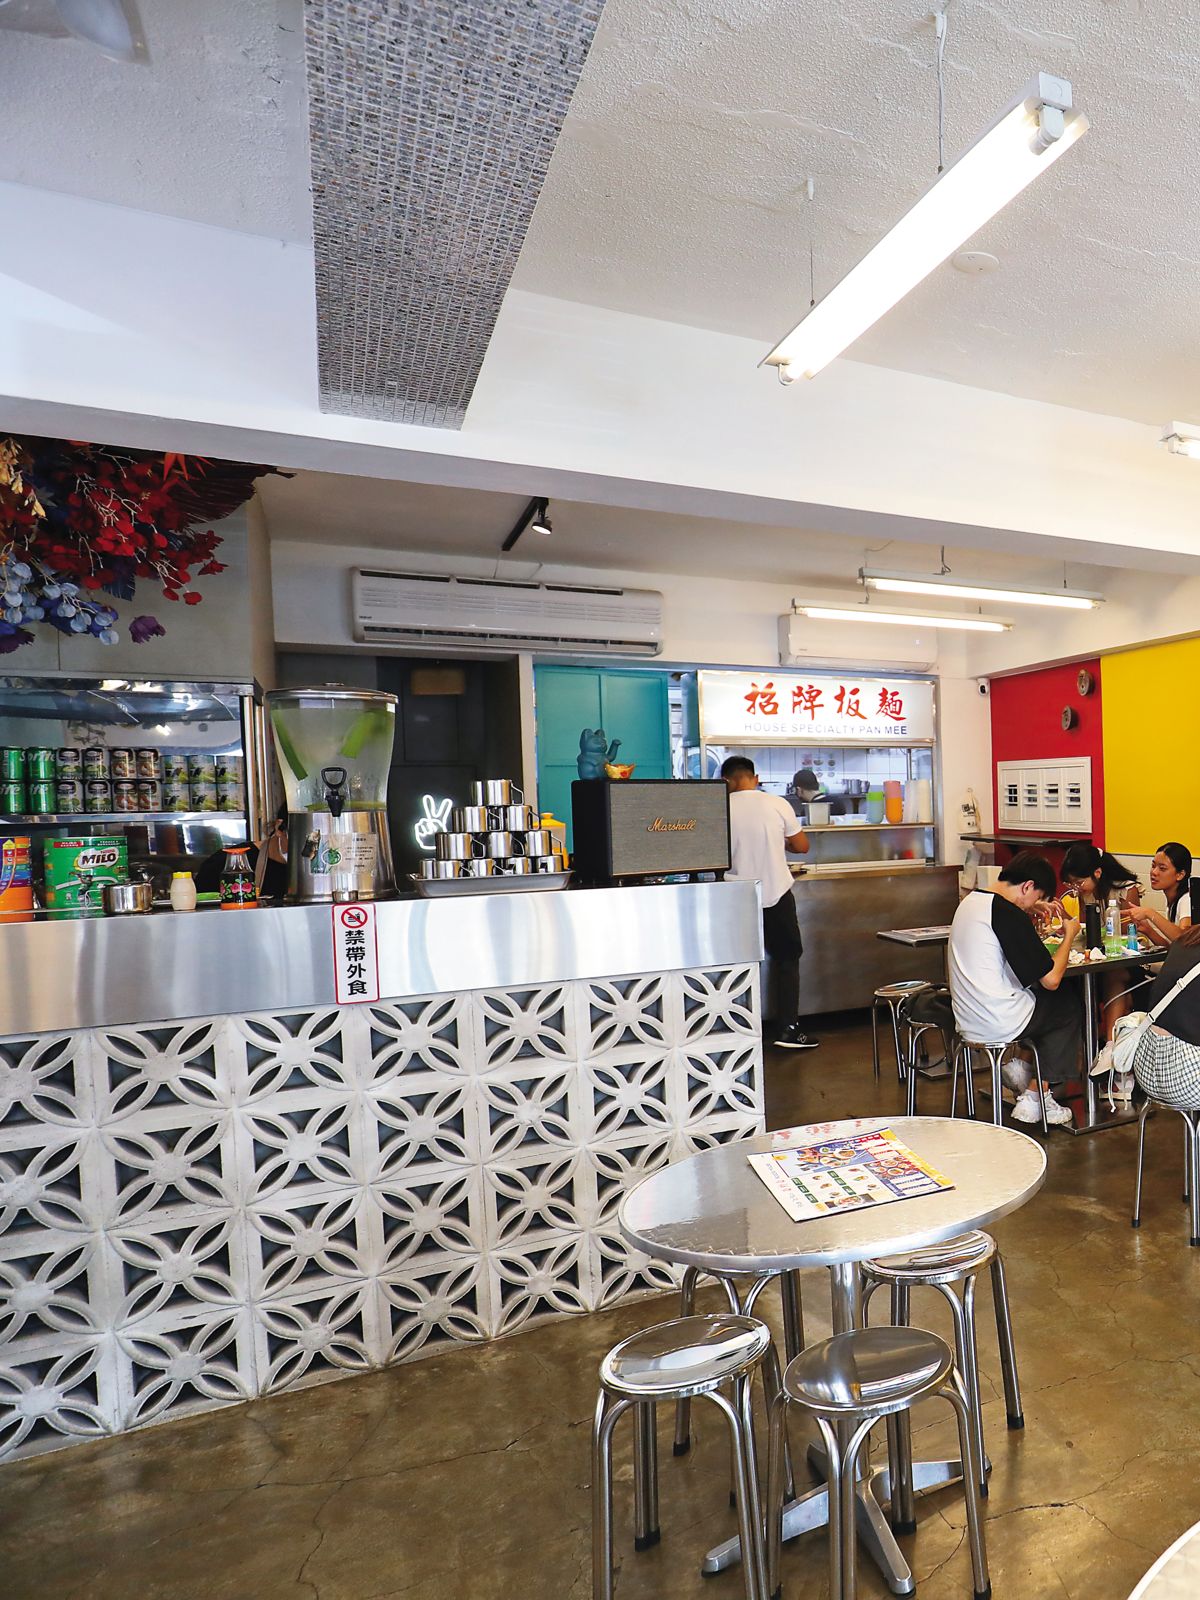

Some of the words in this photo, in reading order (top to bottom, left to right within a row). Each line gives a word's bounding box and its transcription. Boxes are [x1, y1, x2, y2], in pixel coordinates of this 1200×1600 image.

[743, 681, 907, 722] 招牌板麵
[744, 722, 788, 732] HOUSE
[791, 724, 856, 734] SPECIALTY
[859, 725, 881, 735] PAN
[884, 725, 908, 735] MEE
[646, 816, 698, 832] Marshall
[81, 853, 117, 866] MILO
[344, 929, 368, 996] 禁帶外食
